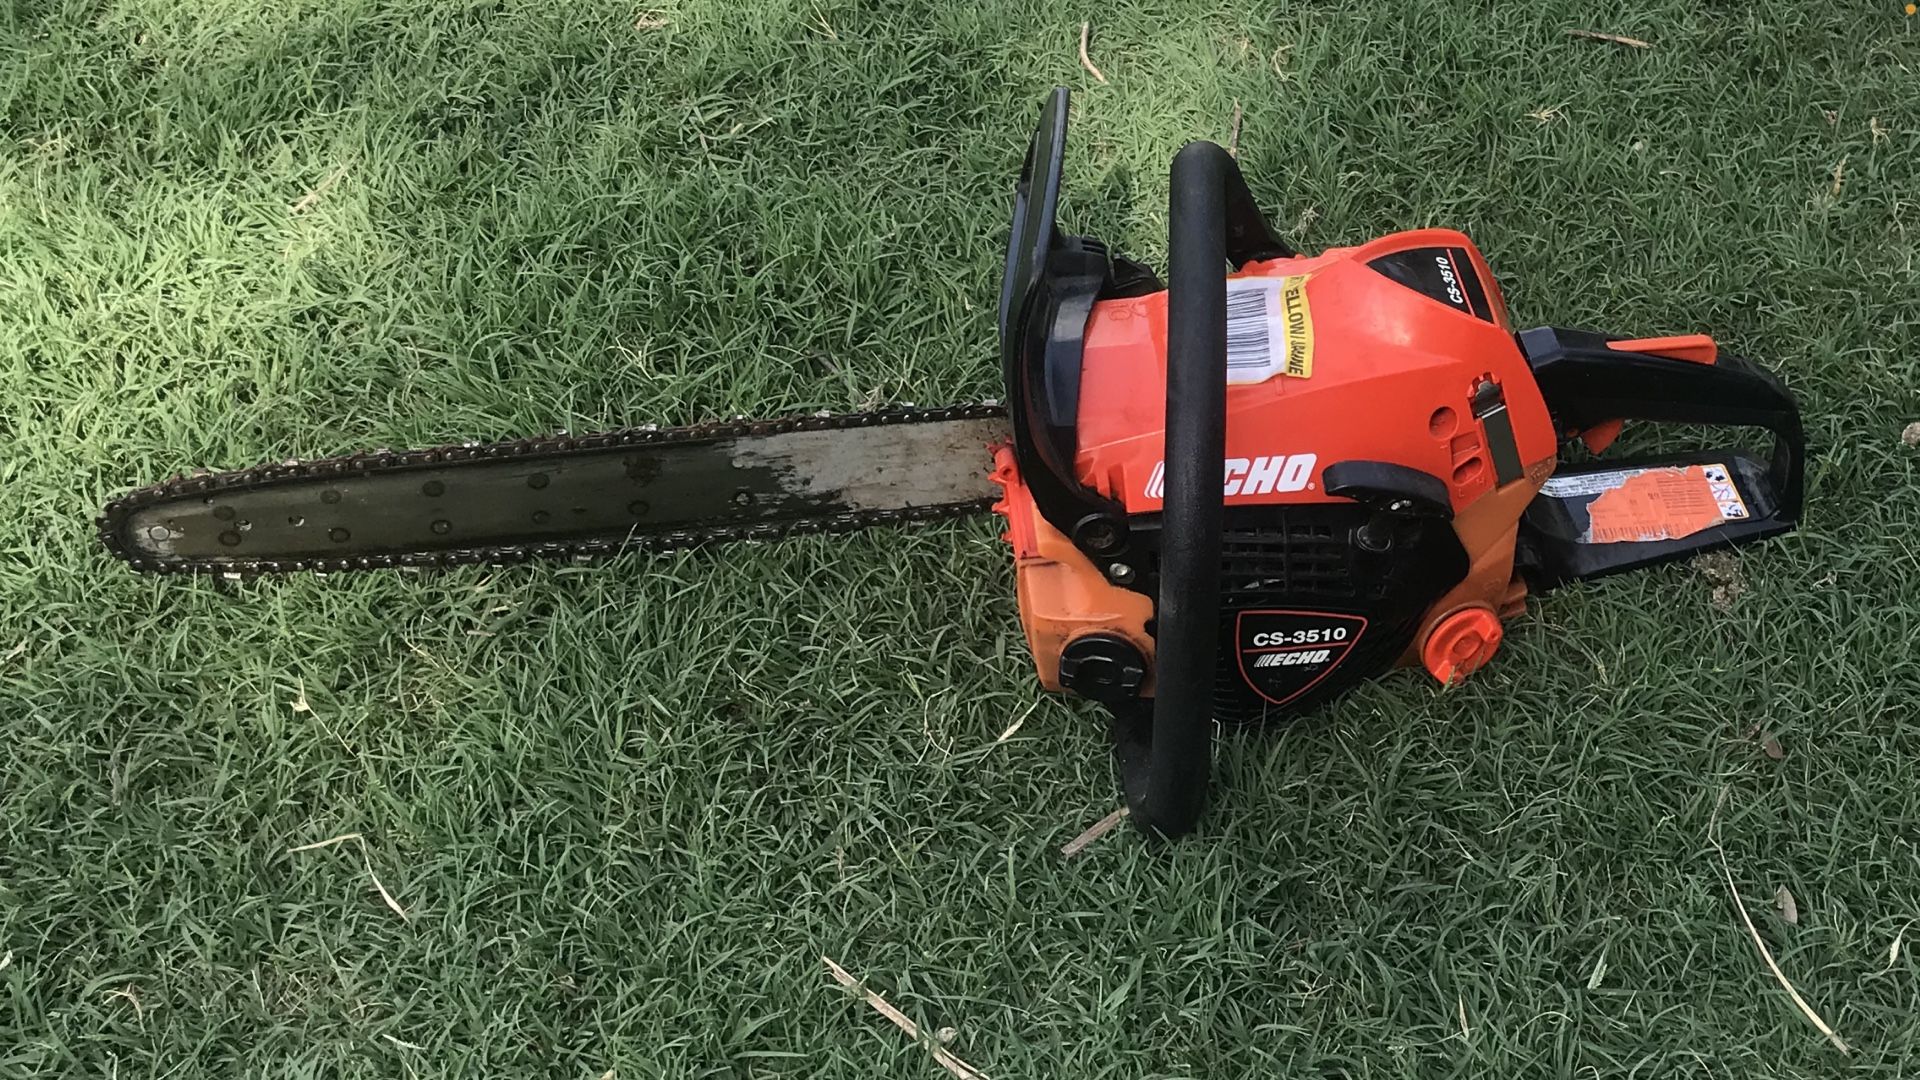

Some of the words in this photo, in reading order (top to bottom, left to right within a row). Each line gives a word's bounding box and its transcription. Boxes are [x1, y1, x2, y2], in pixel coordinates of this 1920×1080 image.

[1436, 257, 1463, 304] CS-3510
[1192, 453, 1317, 497] CHO
[1253, 627, 1347, 647] CS-3510
[1269, 650, 1330, 667] ECHO
